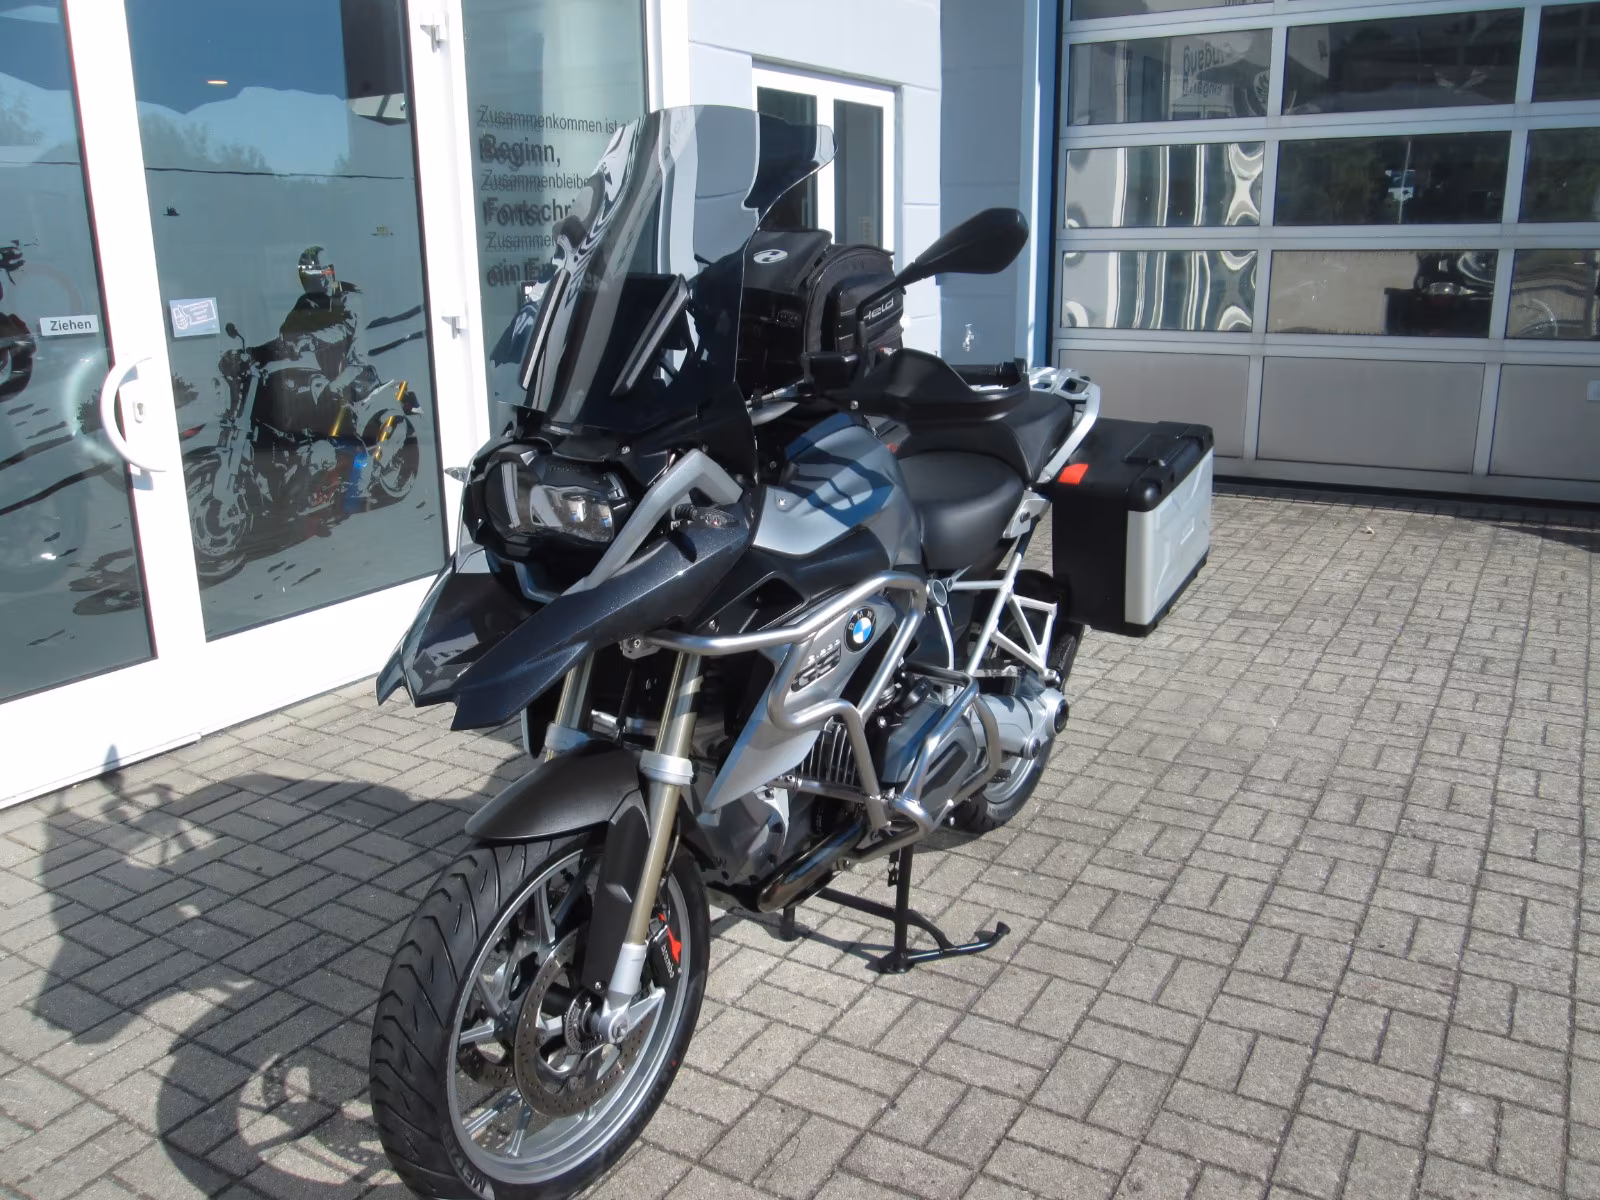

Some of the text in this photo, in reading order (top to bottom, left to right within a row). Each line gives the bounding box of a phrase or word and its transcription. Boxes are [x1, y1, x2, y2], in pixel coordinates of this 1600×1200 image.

[479, 105, 602, 133] Zusammenkommen
[605, 117, 618, 134] ist
[482, 134, 561, 167] Beginn,
[50, 319, 92, 332] Ziehen
[661, 944, 675, 978] brembo
